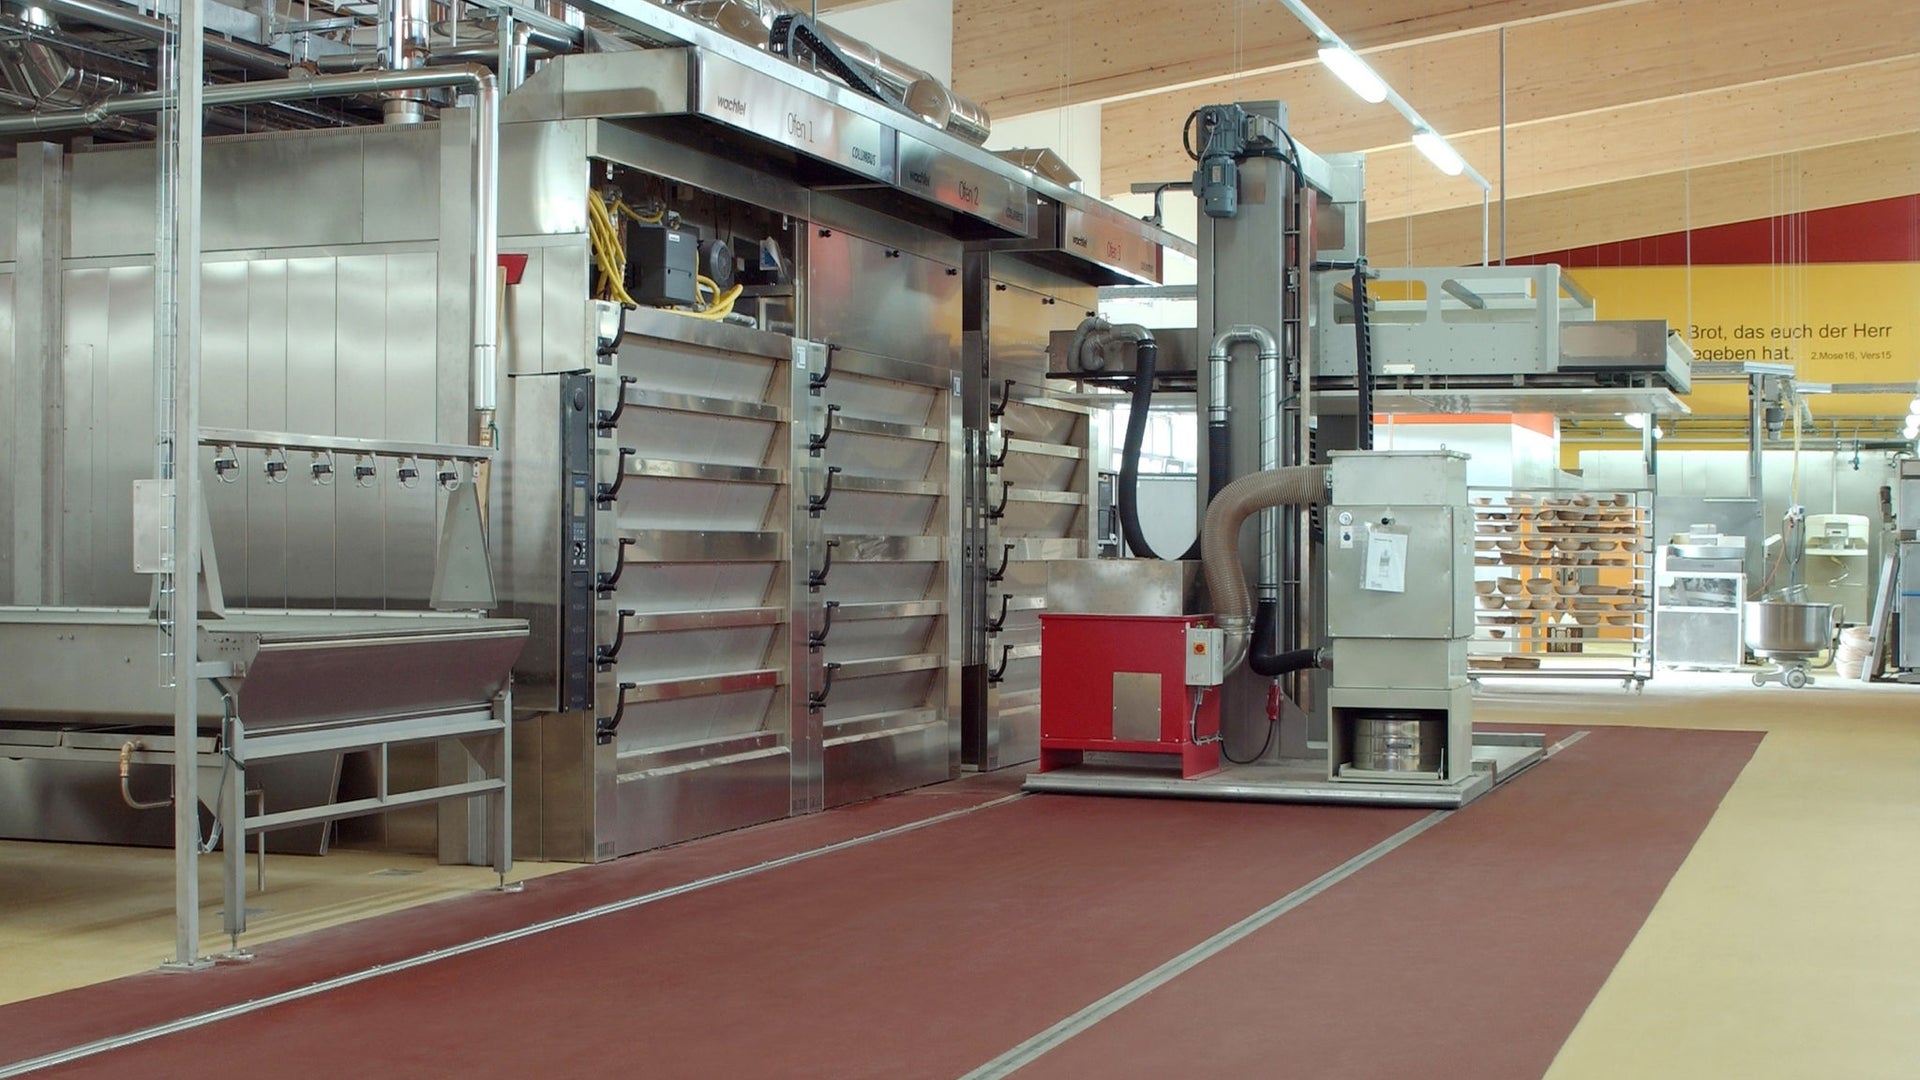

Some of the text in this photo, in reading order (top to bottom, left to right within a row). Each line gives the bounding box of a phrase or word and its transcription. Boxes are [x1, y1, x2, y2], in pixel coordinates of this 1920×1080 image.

[717, 96, 747, 116] wachtel
[787, 112, 815, 143] Ofen 1
[959, 180, 979, 206] Ofen 2
[1690, 325, 1727, 340] Brot,
[1734, 324, 1765, 339] das
[1771, 324, 1812, 339] euch
[1819, 324, 1848, 338] der
[1854, 323, 1893, 338] Herr
[1693, 346, 1794, 361] egeben hat.
[1811, 351, 1892, 361] 2.Mose16, Vers15
